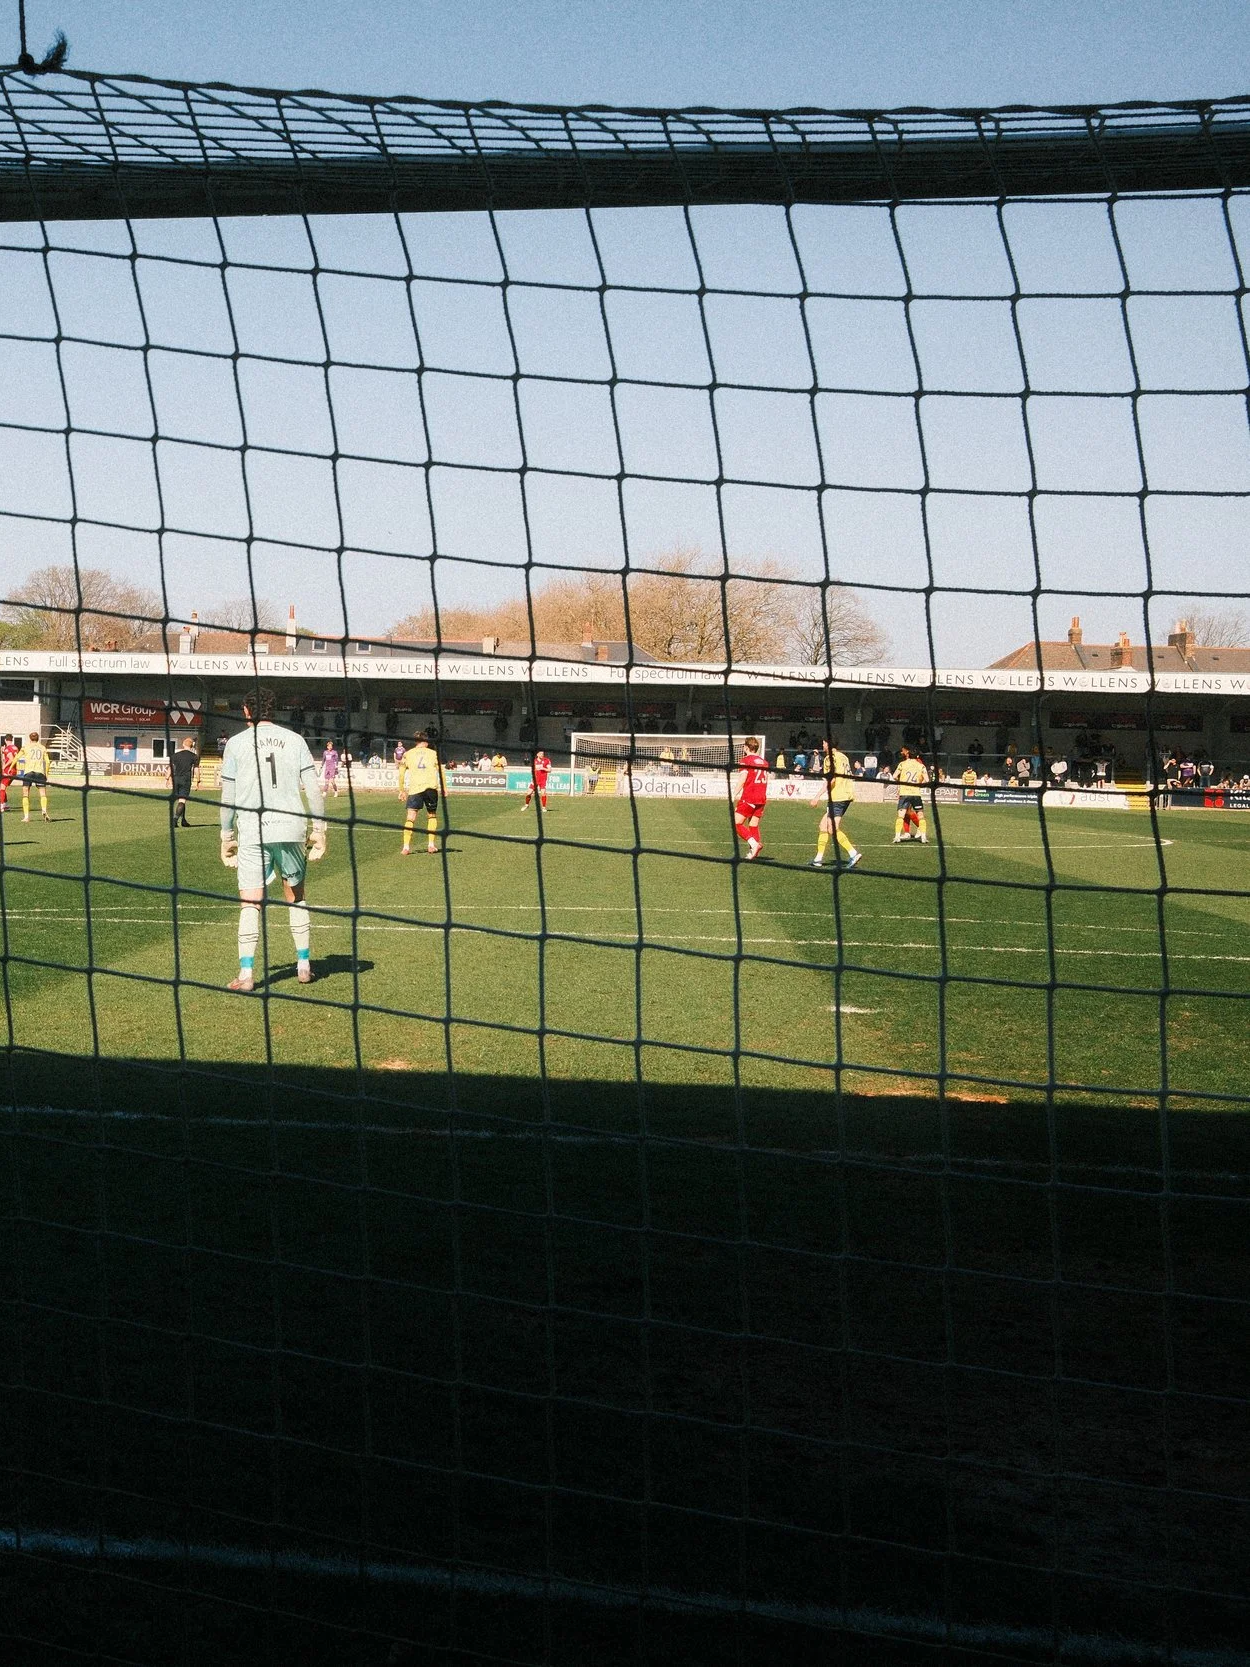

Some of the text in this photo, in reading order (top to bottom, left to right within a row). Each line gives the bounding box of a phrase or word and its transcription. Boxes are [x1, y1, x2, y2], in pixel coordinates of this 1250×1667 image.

[49, 656, 68, 667] Full
[130, 658, 150, 668] law
[90, 702, 120, 714] WCR
[121, 702, 156, 717] Group
[30, 749, 42, 760] 20
[120, 763, 148, 772] JOHN
[150, 763, 170, 772] LAK
[417, 756, 426, 768] 4
[265, 752, 278, 790] 1
[906, 770, 918, 783] 24
[446, 774, 506, 786] enterprise
[644, 778, 707, 794] darnells
